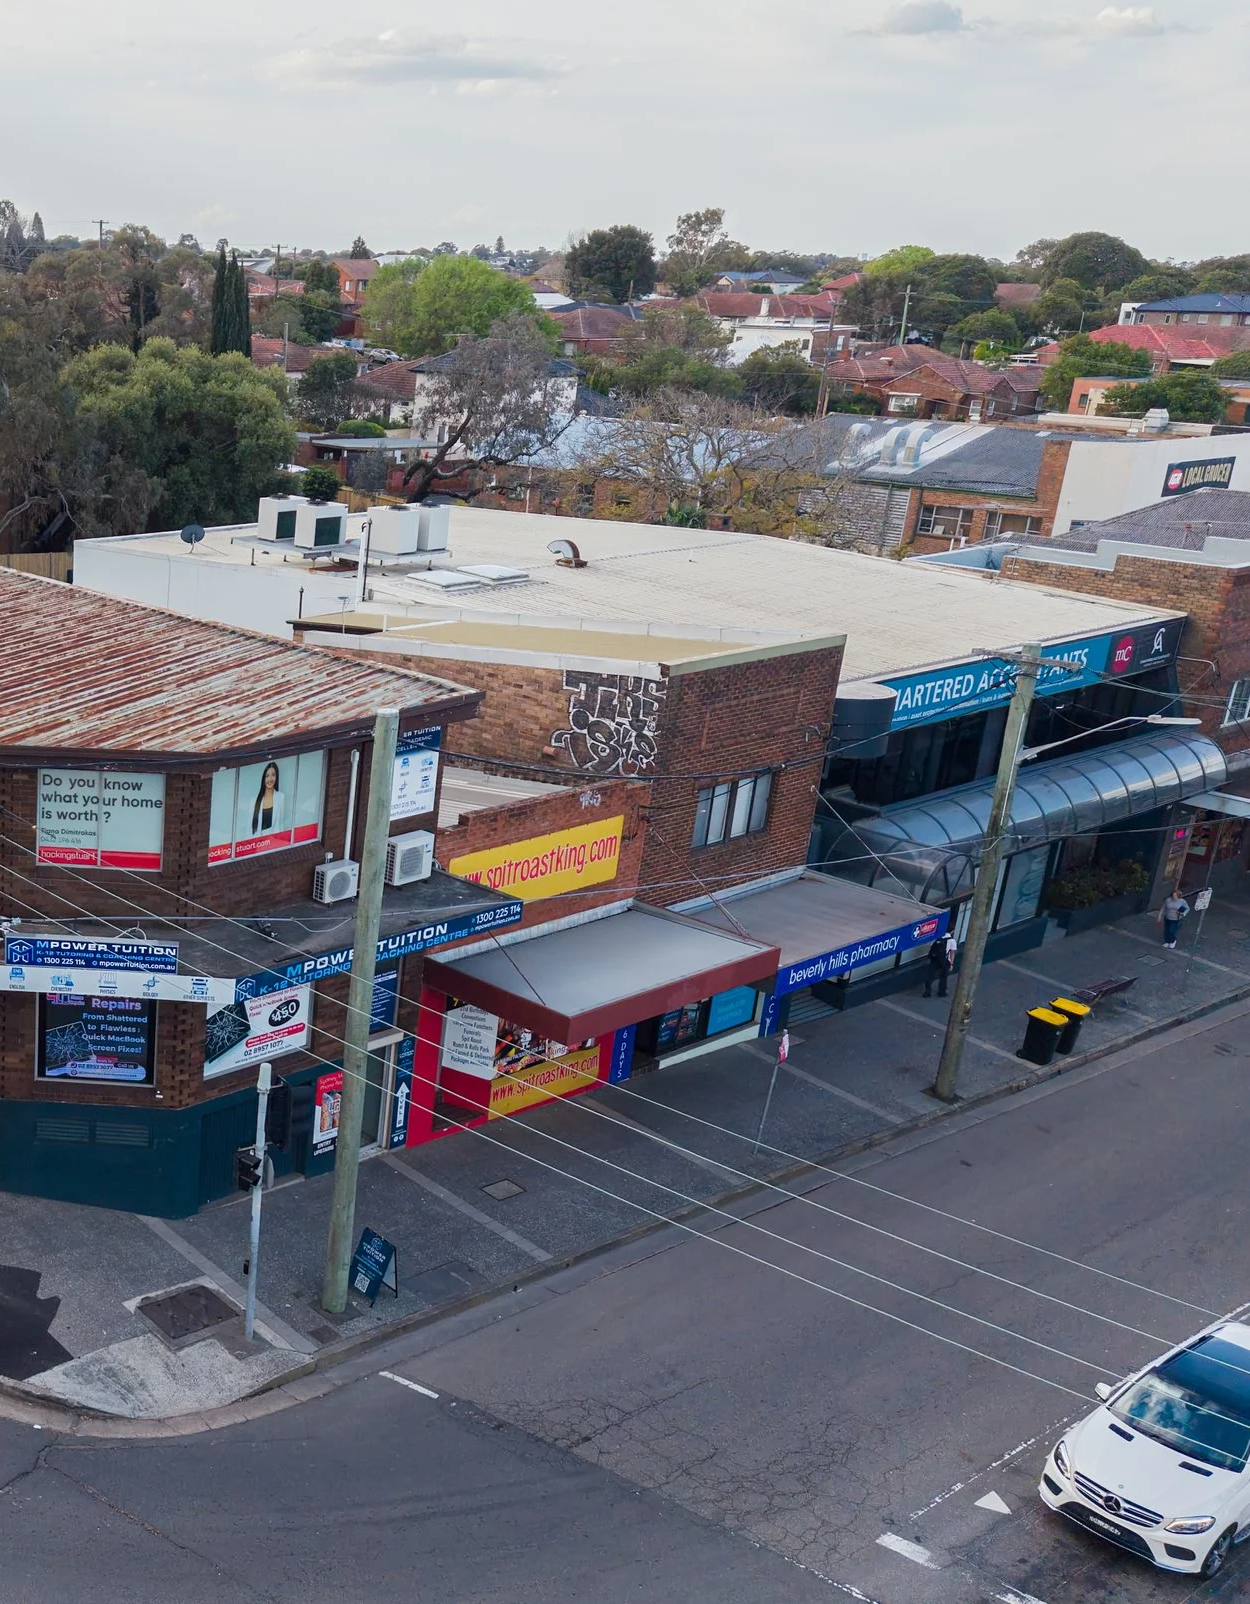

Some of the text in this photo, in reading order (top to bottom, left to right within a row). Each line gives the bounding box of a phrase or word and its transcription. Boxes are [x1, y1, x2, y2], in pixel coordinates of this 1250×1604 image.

[1182, 466, 1205, 488] LOCAL
[1204, 463, 1232, 482] GROCER
[42, 774, 143, 791] Do you know
[42, 791, 79, 803] what
[121, 796, 163, 808] home
[41, 807, 52, 819] is
[56, 810, 97, 821] worth
[41, 850, 95, 861] hockingstuart
[476, 904, 521, 924] 1300 225 114
[475, 915, 520, 931] mpowertuition.com.au
[37, 941, 177, 956] MPOWER TUITION
[287, 923, 448, 978] MPOWE TUITION
[103, 953, 143, 961] COACHING
[260, 929, 468, 995] K-12 TUTORING OACHING CENTRE
[789, 935, 900, 985] beverly hills pharmacy
[99, 960, 176, 971] mpowertuition.com.au
[92, 998, 142, 1010] Repairs
[83, 1013, 148, 1023] From Shattered
[271, 1002, 297, 1021] $450
[101, 1024, 136, 1032] Flawless
[623, 1030, 628, 1039] 6
[82, 1033, 145, 1043] Quick MacBook
[88, 1044, 115, 1052] Screen
[253, 1043, 269, 1054] 8957
[617, 1042, 627, 1078] DAYS
